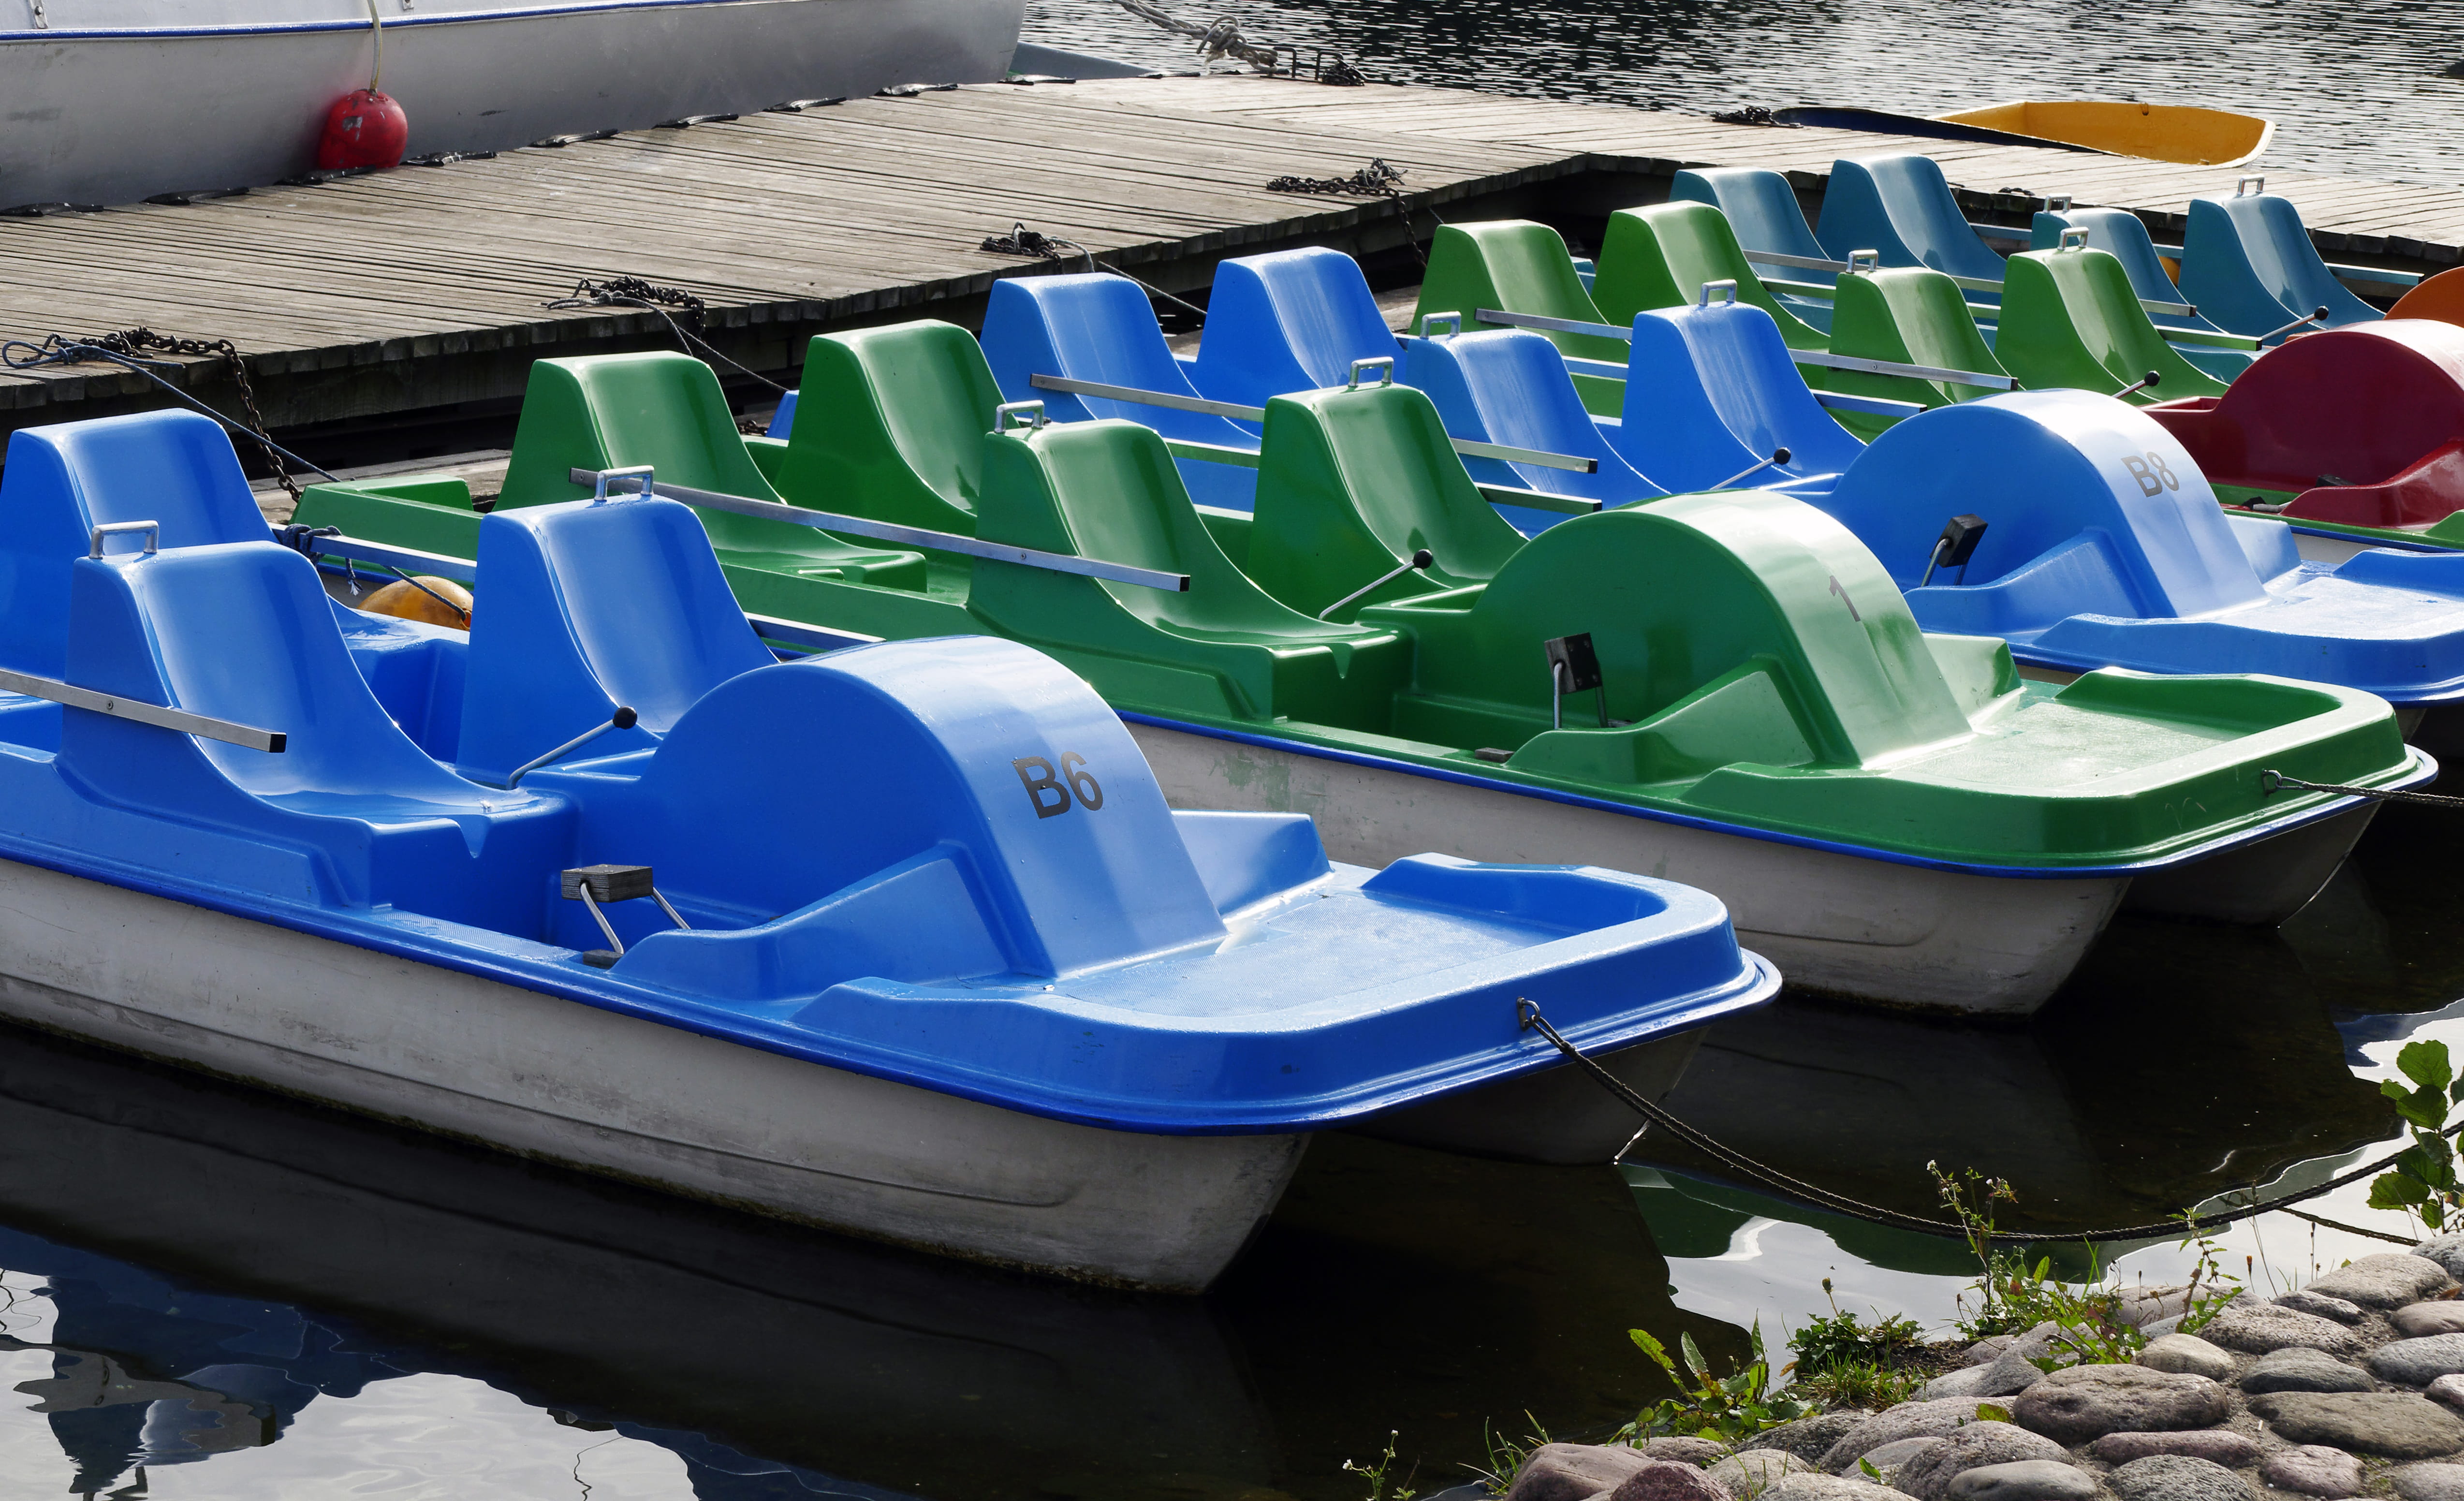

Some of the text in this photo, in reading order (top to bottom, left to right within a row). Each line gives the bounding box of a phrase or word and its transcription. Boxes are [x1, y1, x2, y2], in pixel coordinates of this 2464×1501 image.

[2121, 452, 2179, 497] B8
[1829, 575, 1861, 622] 1
[1011, 751, 1103, 819] B6
